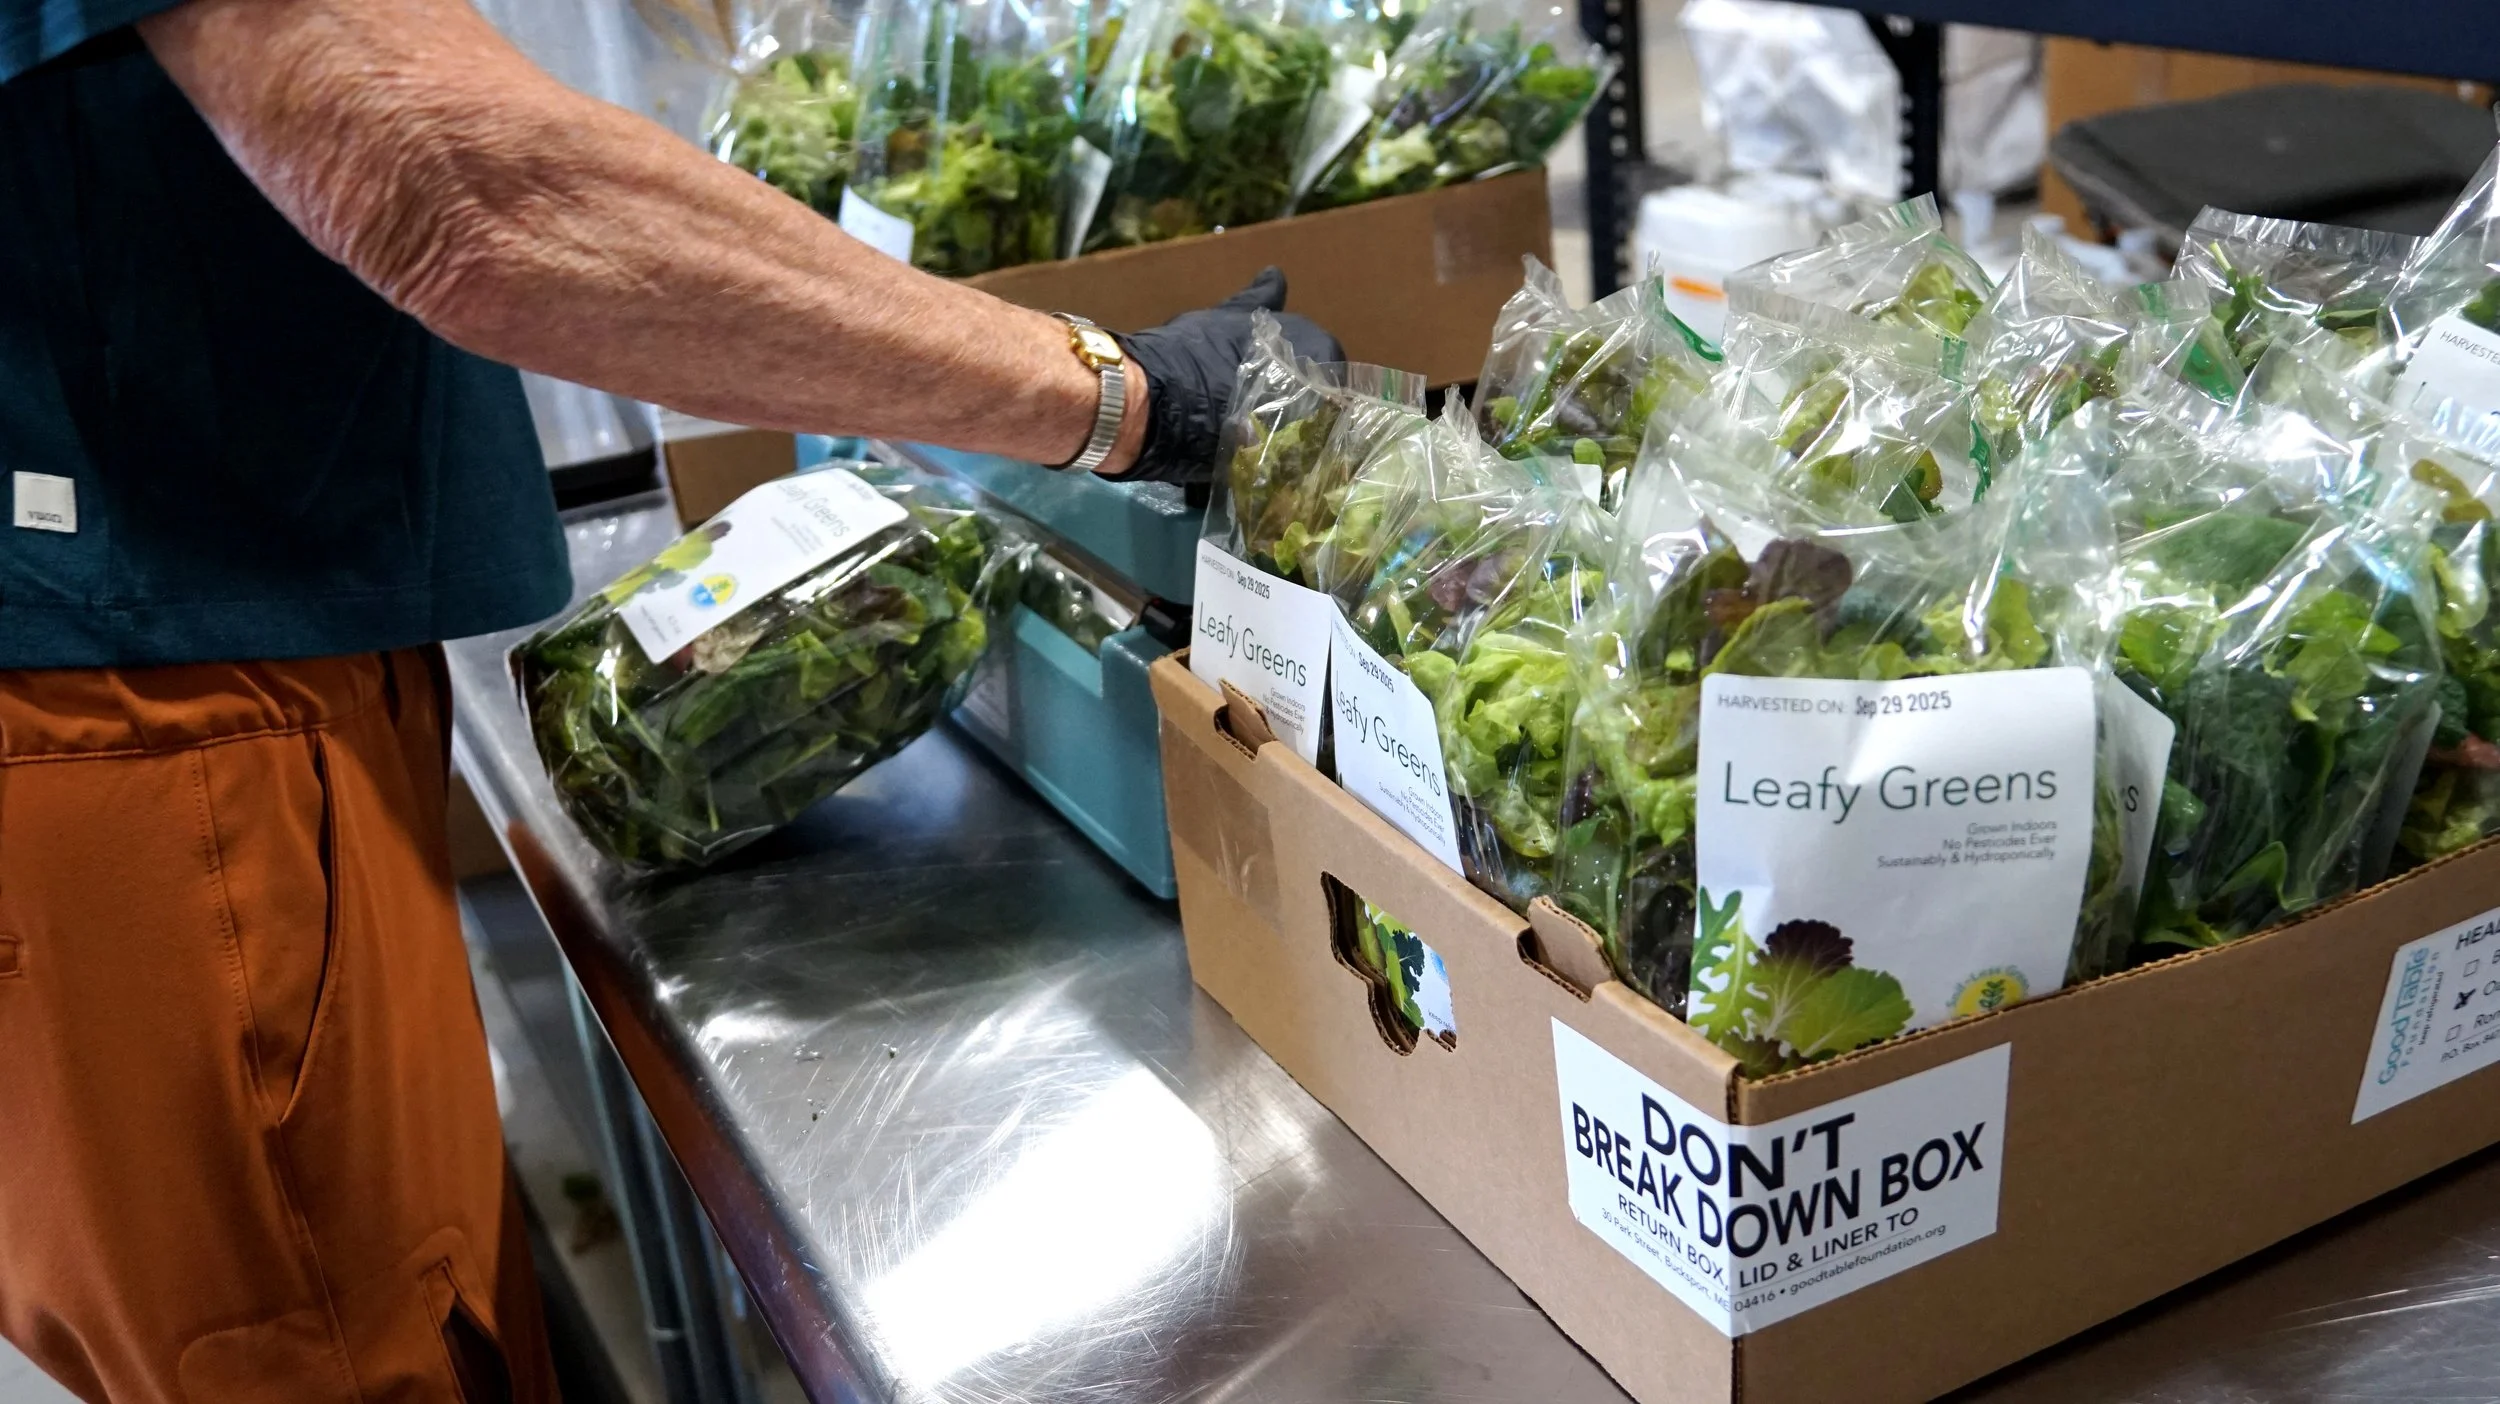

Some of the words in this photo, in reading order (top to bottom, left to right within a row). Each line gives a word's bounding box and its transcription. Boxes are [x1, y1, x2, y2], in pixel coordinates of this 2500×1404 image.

[803, 497, 850, 537] Greens
[1237, 570, 1247, 590] Sep
[1247, 576, 1255, 592] 29
[1255, 580, 1270, 600] 2025
[1198, 601, 1239, 659] Leafy
[1242, 627, 1307, 687] Greens
[1358, 651, 1371, 675] Sep
[1370, 661, 1380, 680] 29
[1379, 668, 1395, 693] 2025
[1335, 669, 1368, 744] Leafy
[1373, 715, 1442, 798] Greens
[1716, 693, 1813, 714] HARVESTED
[1856, 695, 1878, 719] Sep
[1881, 695, 1904, 715] 29
[1907, 689, 1953, 713] 2025
[1724, 760, 1862, 825] Leafy
[1879, 765, 2058, 811] Greens
[1877, 852, 1947, 868] Sustainably
[1950, 851, 1961, 864] &
[1964, 847, 2056, 867] Hydroponically
[1943, 838, 1962, 851] No
[1965, 834, 2027, 850] Pesticides
[2030, 832, 2058, 846] Ever
[1966, 822, 2008, 836] Grown
[2011, 819, 2058, 832] Indoors
[2390, 947, 2430, 1021] Table
[2377, 1015, 2411, 1085] Good
[1642, 1092, 1856, 1198] DON'T
[1572, 1101, 1688, 1229] BREAK
[1697, 1168, 1862, 1259] DOWN
[1880, 1122, 1987, 1208] BOX
[1601, 1207, 1613, 1224] 30
[1614, 1216, 1633, 1238] Park
[1715, 1292, 1731, 1313] ME
[1734, 1291, 1776, 1312] 04416
[1789, 1224, 1947, 1296] goodtablefoundation.org
[1618, 1192, 1683, 1255] RETURN
[1687, 1243, 1730, 1292] BOX,
[1739, 1262, 1778, 1289] LID
[1786, 1253, 1804, 1272] &
[1812, 1221, 1879, 1263] LINER
[1886, 1206, 1919, 1232] TO
